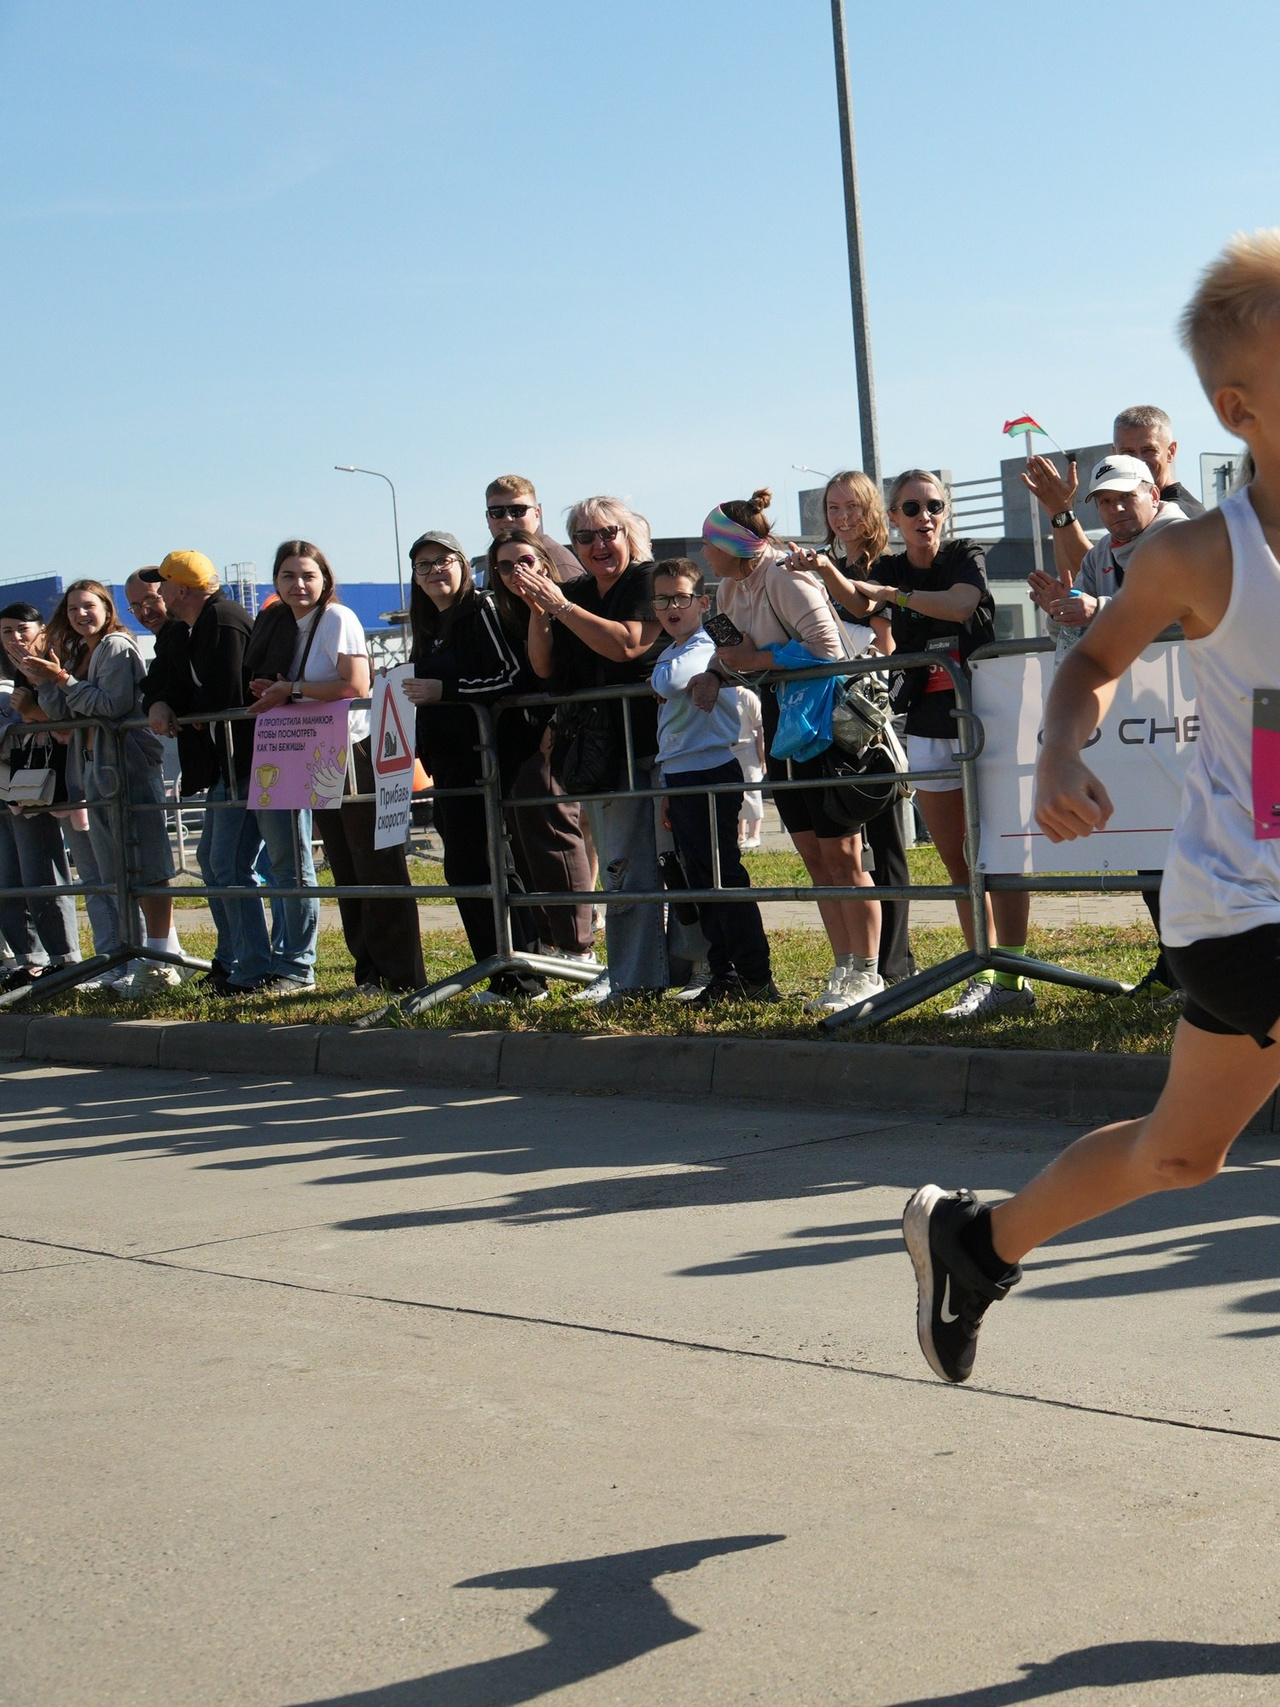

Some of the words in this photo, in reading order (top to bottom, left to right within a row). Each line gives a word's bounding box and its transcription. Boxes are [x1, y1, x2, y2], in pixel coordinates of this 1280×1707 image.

[263, 717, 301, 727] ПРОПУСТИЛА
[257, 730, 277, 739] ЧТОБЫ
[278, 728, 317, 738] ПОСМОТРЕТЬ
[256, 743, 268, 752] КАК
[269, 743, 278, 752] ТЫ
[278, 742, 306, 752] БЕЖИШЬ!
[380, 783, 410, 810] Прибавь
[377, 804, 409, 833] скорости!
